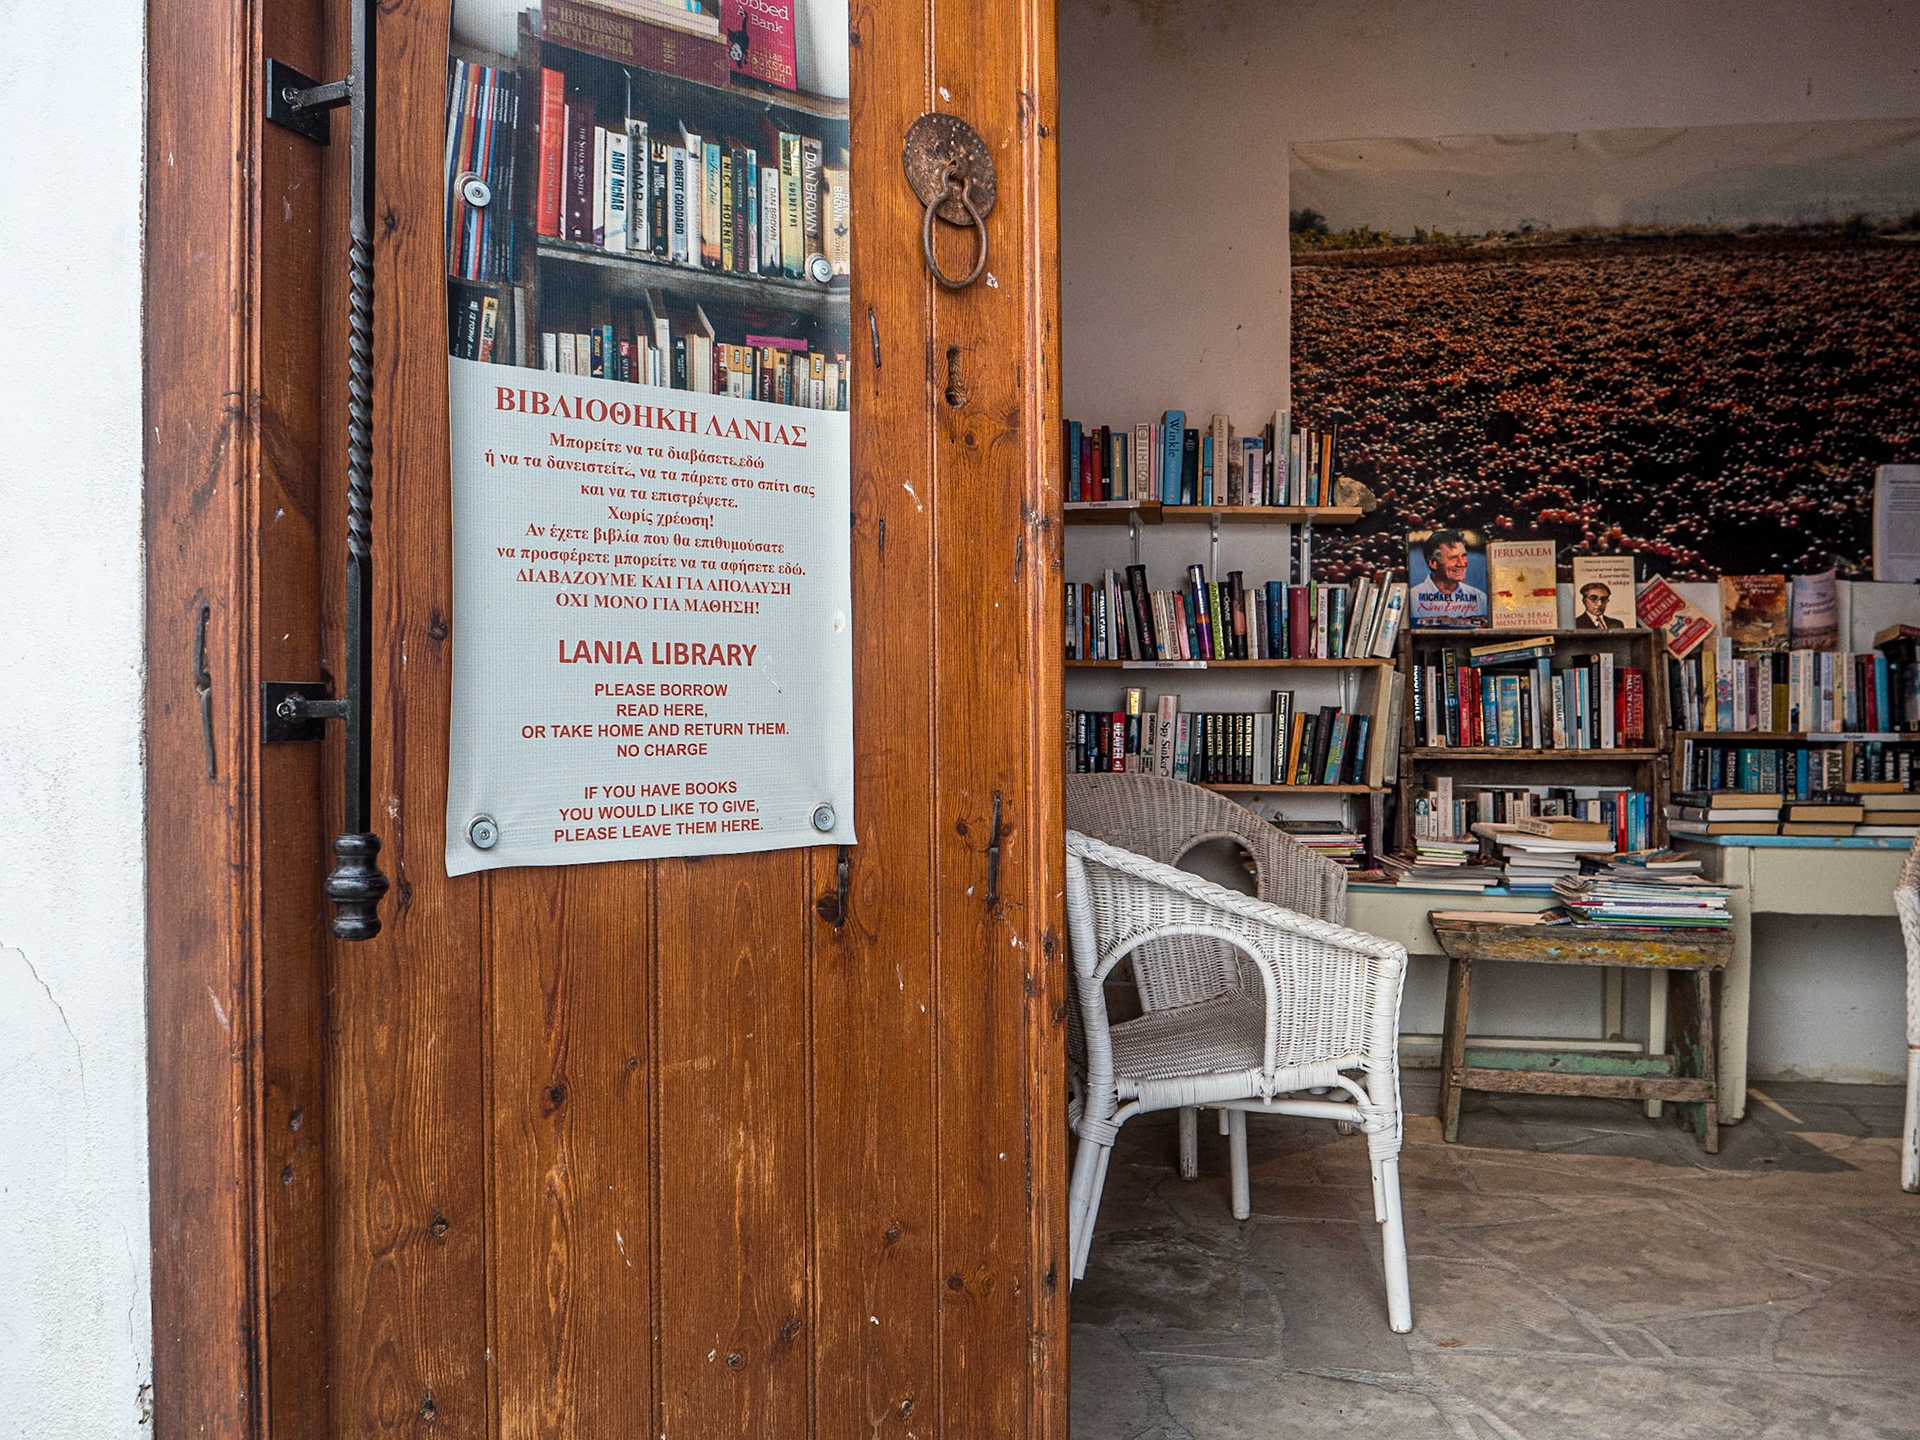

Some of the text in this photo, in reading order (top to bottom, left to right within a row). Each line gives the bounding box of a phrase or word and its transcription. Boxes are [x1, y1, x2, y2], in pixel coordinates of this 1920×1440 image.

[737, 0, 789, 20] obbed
[751, 14, 783, 34] Bank
[611, 151, 625, 211] ANDY McNAB
[805, 151, 817, 232] DAN BROWN
[675, 159, 684, 234] ROBERT GODDARD
[723, 162, 732, 252] NICK HORNBY
[833, 186, 842, 222] BROWN
[495, 386, 808, 447] ΒΙΒΛΙΟΘΗΚΗ ΛΑΝΙΑΣ
[550, 432, 764, 469] Μπορείτε να τα διαβάσετε εδώ
[1168, 419, 1180, 458] Winkle
[485, 450, 494, 467] ή
[501, 454, 519, 465] να
[524, 456, 542, 468] τα
[640, 468, 657, 479] να
[660, 469, 677, 481] τα
[681, 469, 727, 488] πάρετε
[731, 477, 753, 490] στο
[758, 478, 790, 494] σπίτι
[793, 482, 816, 499] σας
[581, 484, 738, 509] και να τα επιστρέψετε.
[607, 506, 714, 528] Χωρίς χρέωση!
[525, 523, 784, 554] Αν έχετε βιβλία που θα επιθυμούσατε
[497, 546, 806, 576] να προσφέρετε μπορείτε να τα αφήσετε εδώ.
[1494, 547, 1552, 559] JERUSALEM
[516, 567, 791, 596] ΔΙΑΒΑΖΟΥΜΕ ΚΑΙ ΓΙΑ ΑΠΟΛΑΥΣΗ
[556, 592, 760, 614] ΟΧΙ ΜΟΝΟ ΓΙΑ ΜΑΘΗΣΗ!
[1419, 593, 1477, 602] MICHAEL PALIN
[558, 639, 757, 667] LANIA LIBRARY
[594, 684, 728, 696] PLEASE BORROW
[616, 704, 708, 718] READ HERE,
[1414, 695, 1422, 721] DOYLE
[522, 722, 789, 738] OR TAKE HOME AND RETURN THEM.
[1161, 721, 1171, 738] Spy
[617, 743, 708, 757] NO CHARGE
[1160, 740, 1170, 770] Sinker
[1786, 752, 1795, 785] ARCHER
[584, 781, 737, 799] IF YOU HAVE BOOKS
[559, 800, 759, 822] YOU WOULD LIKE TO GIVE,
[554, 818, 763, 843] PLEASE LEAVE THEM HERE.
